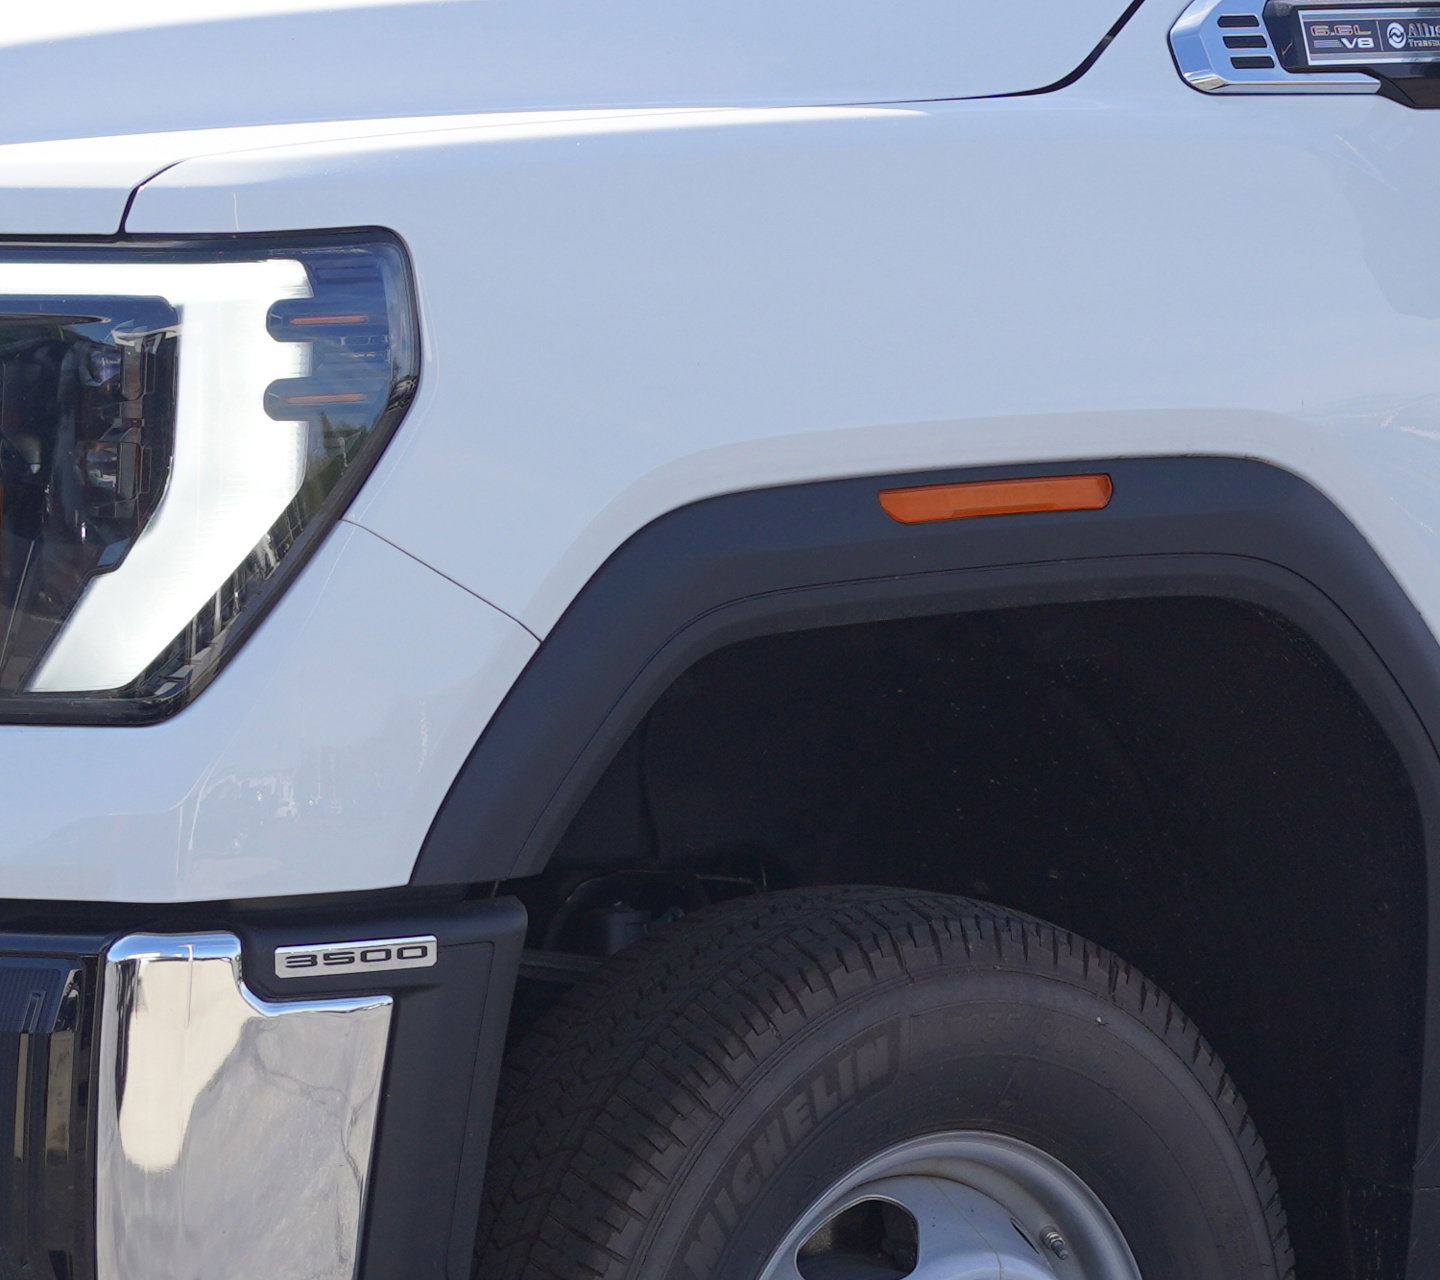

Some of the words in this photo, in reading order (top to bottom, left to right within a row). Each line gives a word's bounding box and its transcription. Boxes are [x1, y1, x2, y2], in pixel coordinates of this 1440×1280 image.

[1310, 24, 1372, 37] 6.6L
[1340, 37, 1375, 49] V8
[284, 945, 429, 969] 3500
